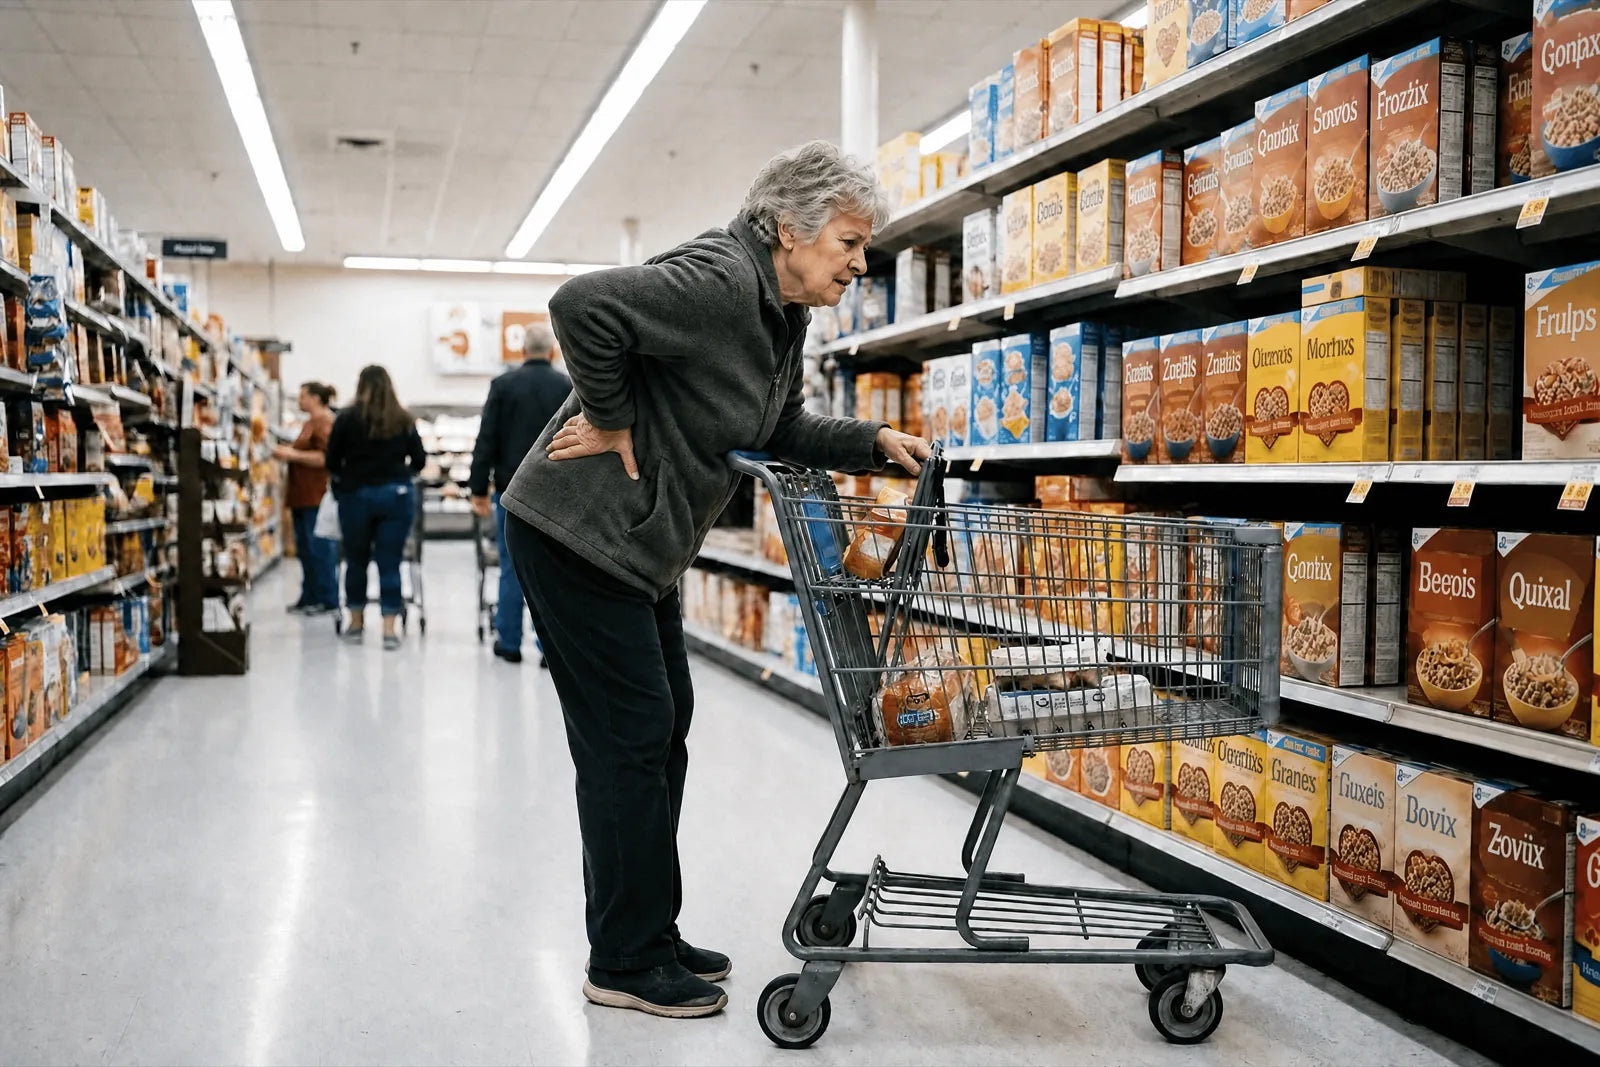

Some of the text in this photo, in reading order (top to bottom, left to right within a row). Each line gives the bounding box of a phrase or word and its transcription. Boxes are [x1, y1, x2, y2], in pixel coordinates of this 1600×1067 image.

[1536, 302, 1597, 342] Frulps
[1509, 571, 1571, 611] Quixal
[1405, 794, 1458, 839] Bovix
